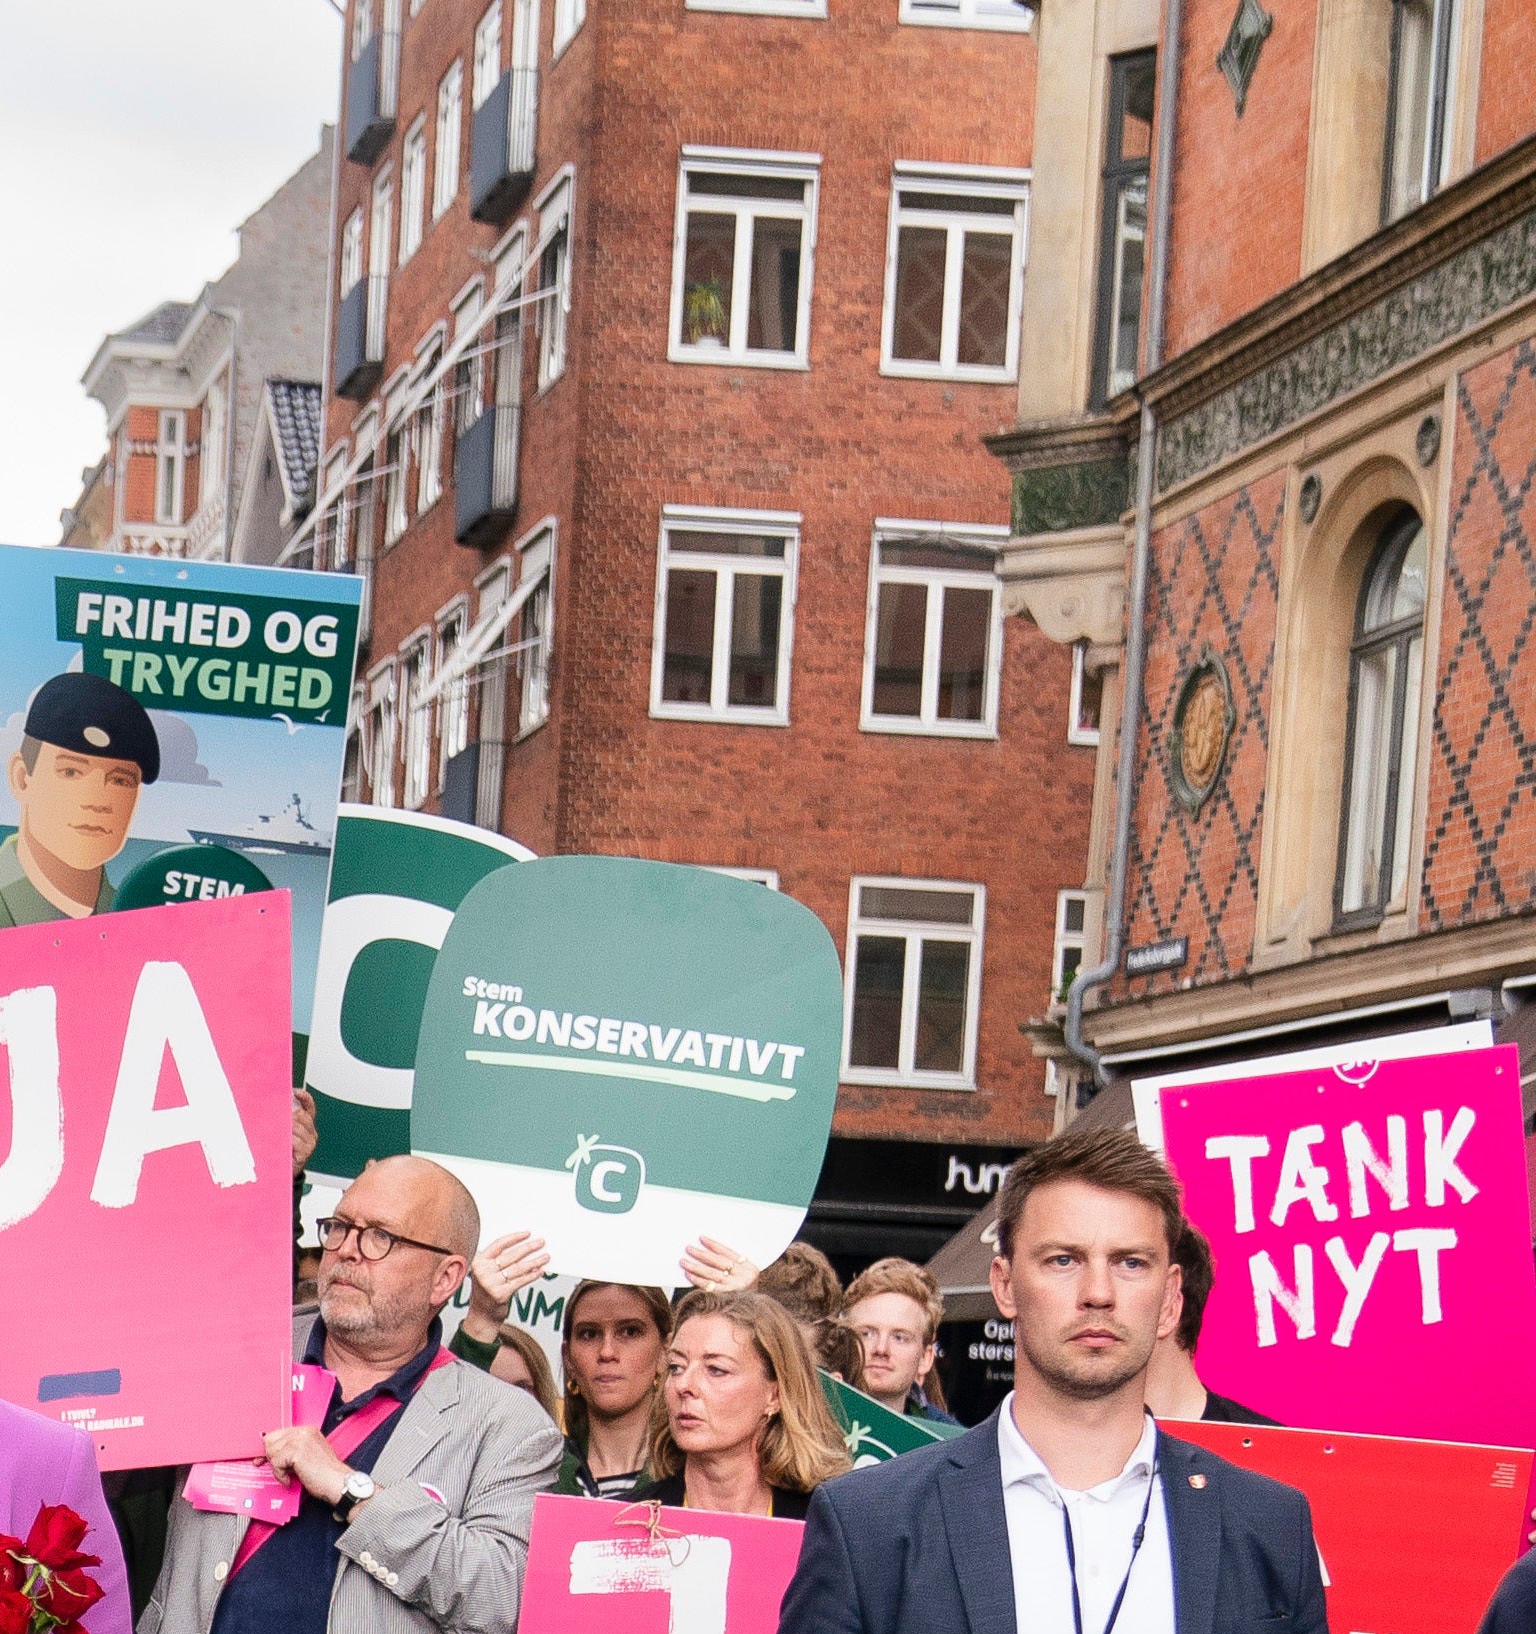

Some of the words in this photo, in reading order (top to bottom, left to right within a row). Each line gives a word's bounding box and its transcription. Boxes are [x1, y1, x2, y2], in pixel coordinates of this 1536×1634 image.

[76, 592, 252, 649] FRIHED
[263, 610, 340, 659] OG
[103, 648, 333, 710] TRYGHED
[463, 975, 523, 1004] Stem
[472, 1000, 806, 1080] KONSERVATIVT
[589, 1160, 627, 1203] C
[1204, 1106, 1481, 1234] TÆNK
[1247, 1228, 1458, 1348] NYT
